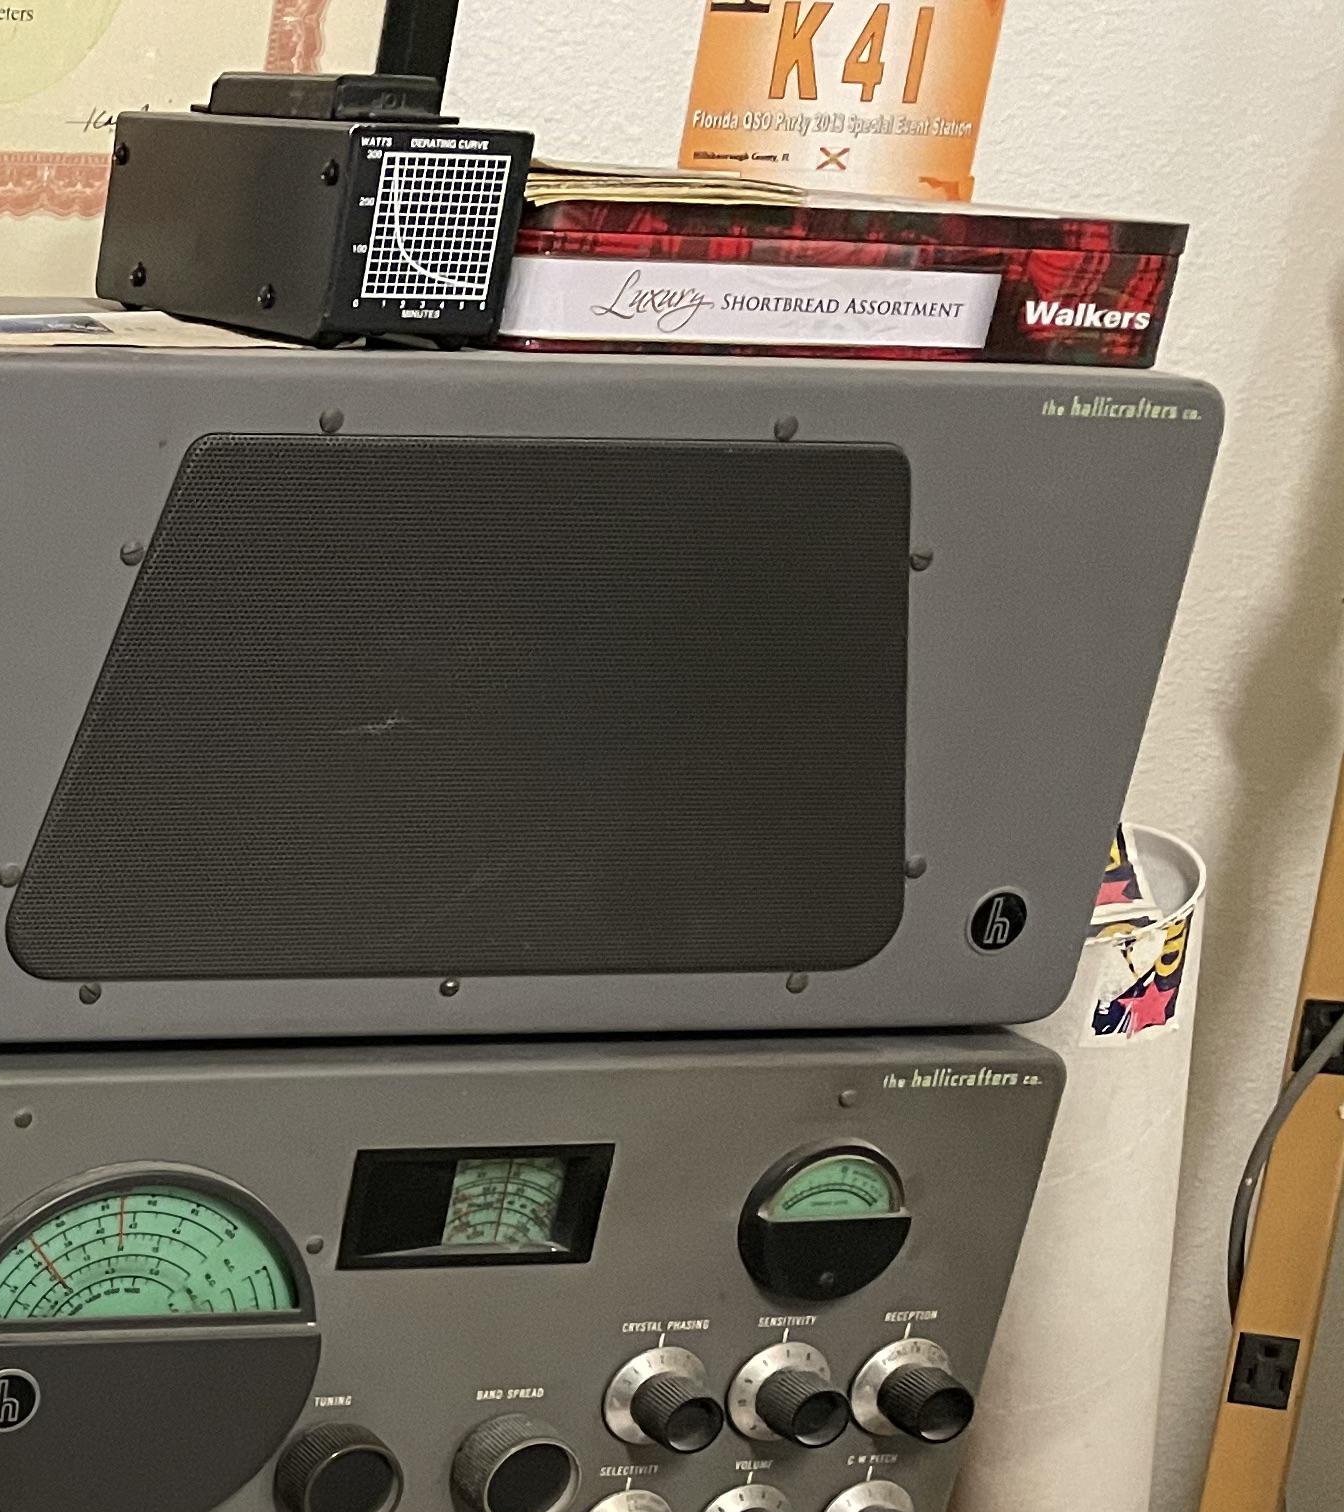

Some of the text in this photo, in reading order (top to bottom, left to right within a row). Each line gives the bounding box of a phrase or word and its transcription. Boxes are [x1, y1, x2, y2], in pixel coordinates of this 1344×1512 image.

[693, 109, 973, 138] Florida QSO Party Special Event Station
[362, 137, 490, 150] WATTS DERATING CURVE
[591, 270, 965, 332] Luxury SHORTBREAD ASSORTMENT
[1023, 300, 1151, 331] Walkers
[1042, 396, 1178, 419] the hallicrafters
[883, 1067, 1019, 1088] the hallicrafters
[758, 1315, 817, 1328] SENSITIVITY
[884, 1310, 938, 1323] RECEPTION
[622, 1319, 710, 1333] CRYSTAL PHASING
[476, 1388, 545, 1401] BAND SPREAD
[314, 1396, 352, 1407] TUNING
[600, 1464, 659, 1477] SELECTIVITY
[735, 1459, 773, 1471] VOLUME
